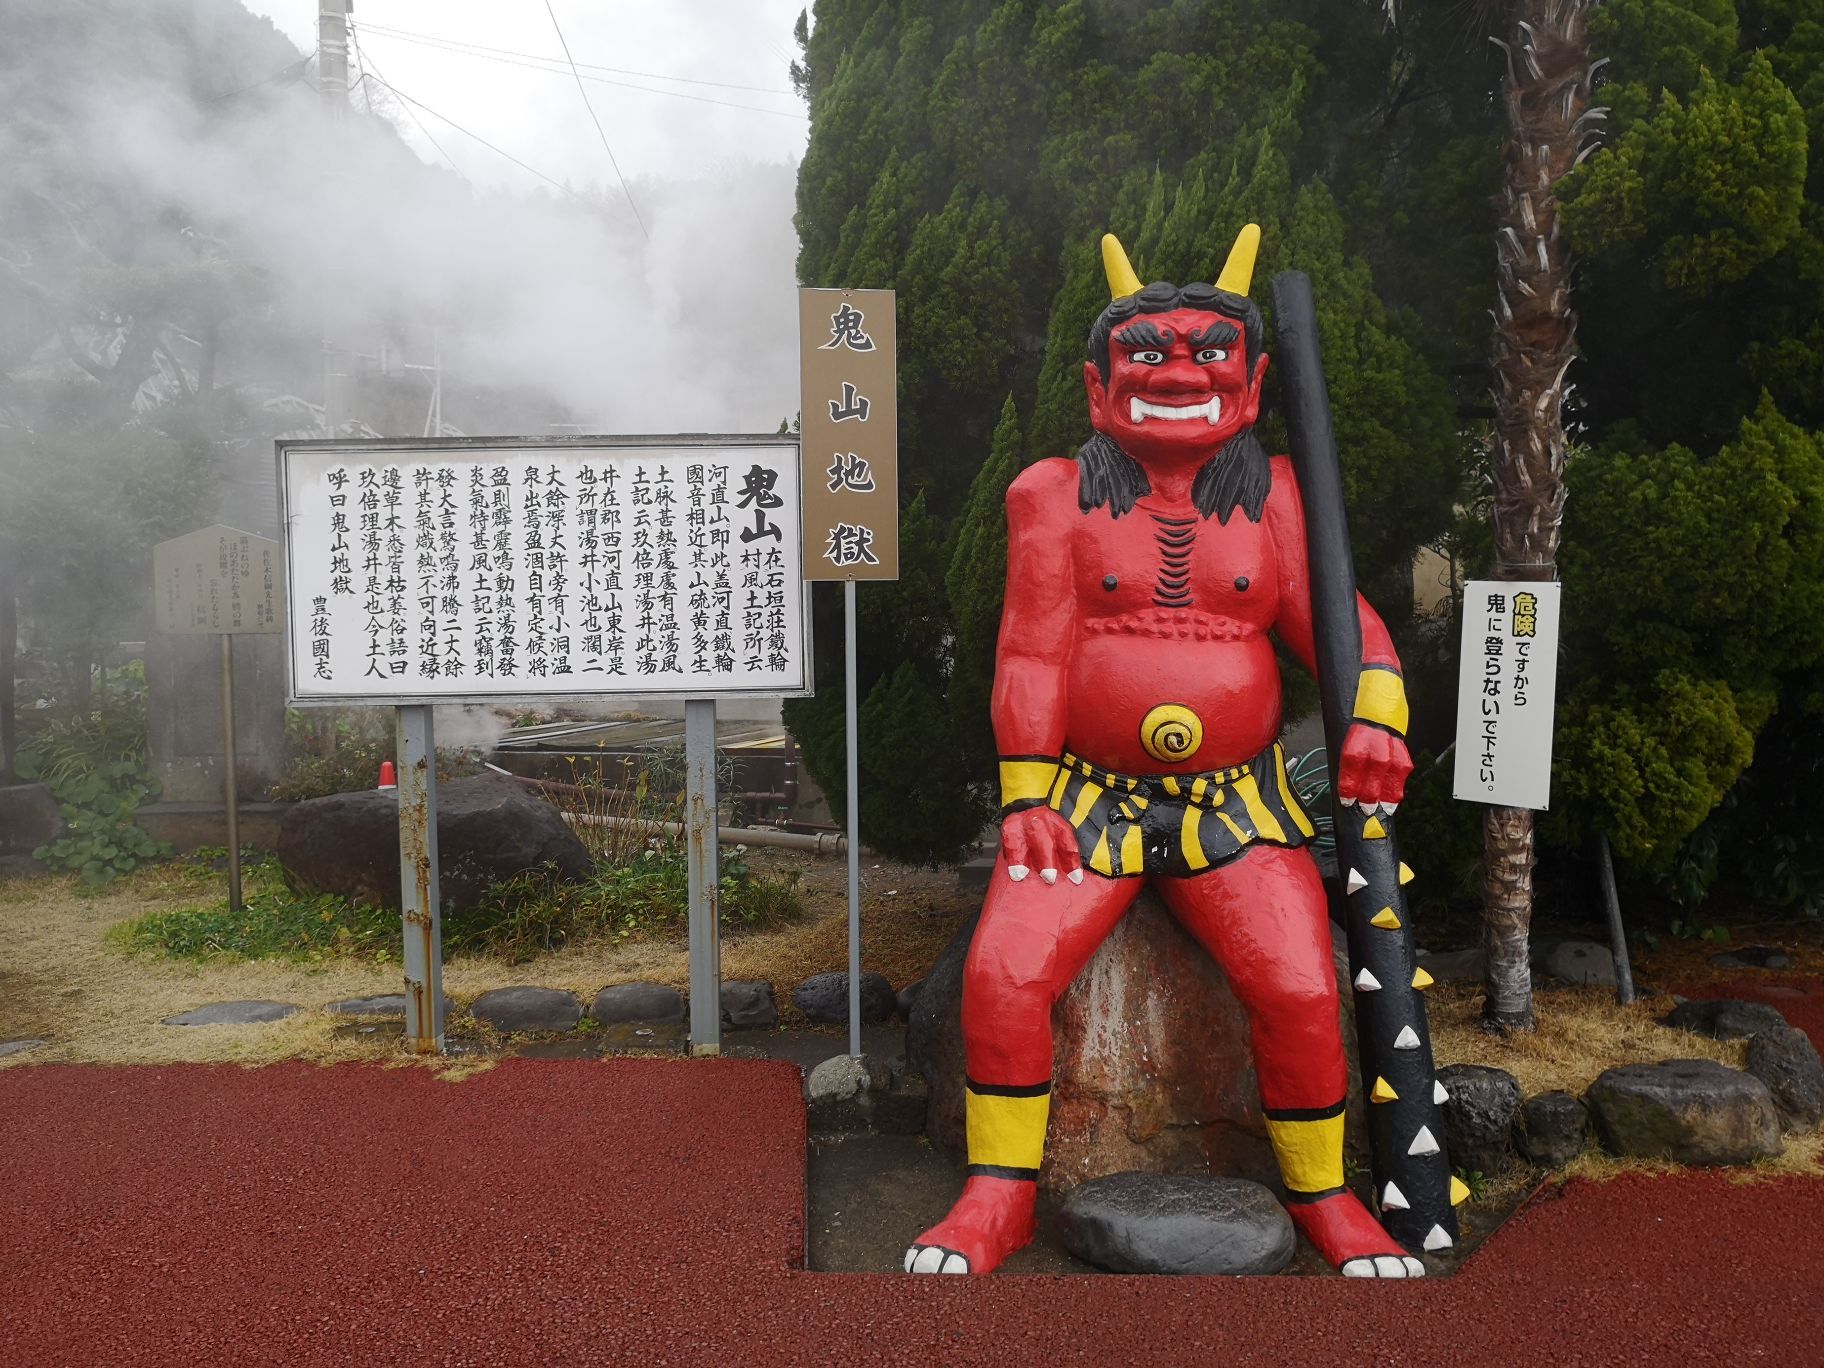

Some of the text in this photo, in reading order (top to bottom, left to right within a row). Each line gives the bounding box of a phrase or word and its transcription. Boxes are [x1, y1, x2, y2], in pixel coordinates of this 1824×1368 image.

[735, 464, 784, 543] 鬼山
[816, 302, 880, 567] 鬼山地獄
[599, 464, 627, 675] 井在郡西河直山東岸是
[740, 548, 764, 672] 村風土記所云
[1511, 591, 1538, 707] 危険ですから
[1479, 593, 1506, 792] 鬼に登らないで下さい。
